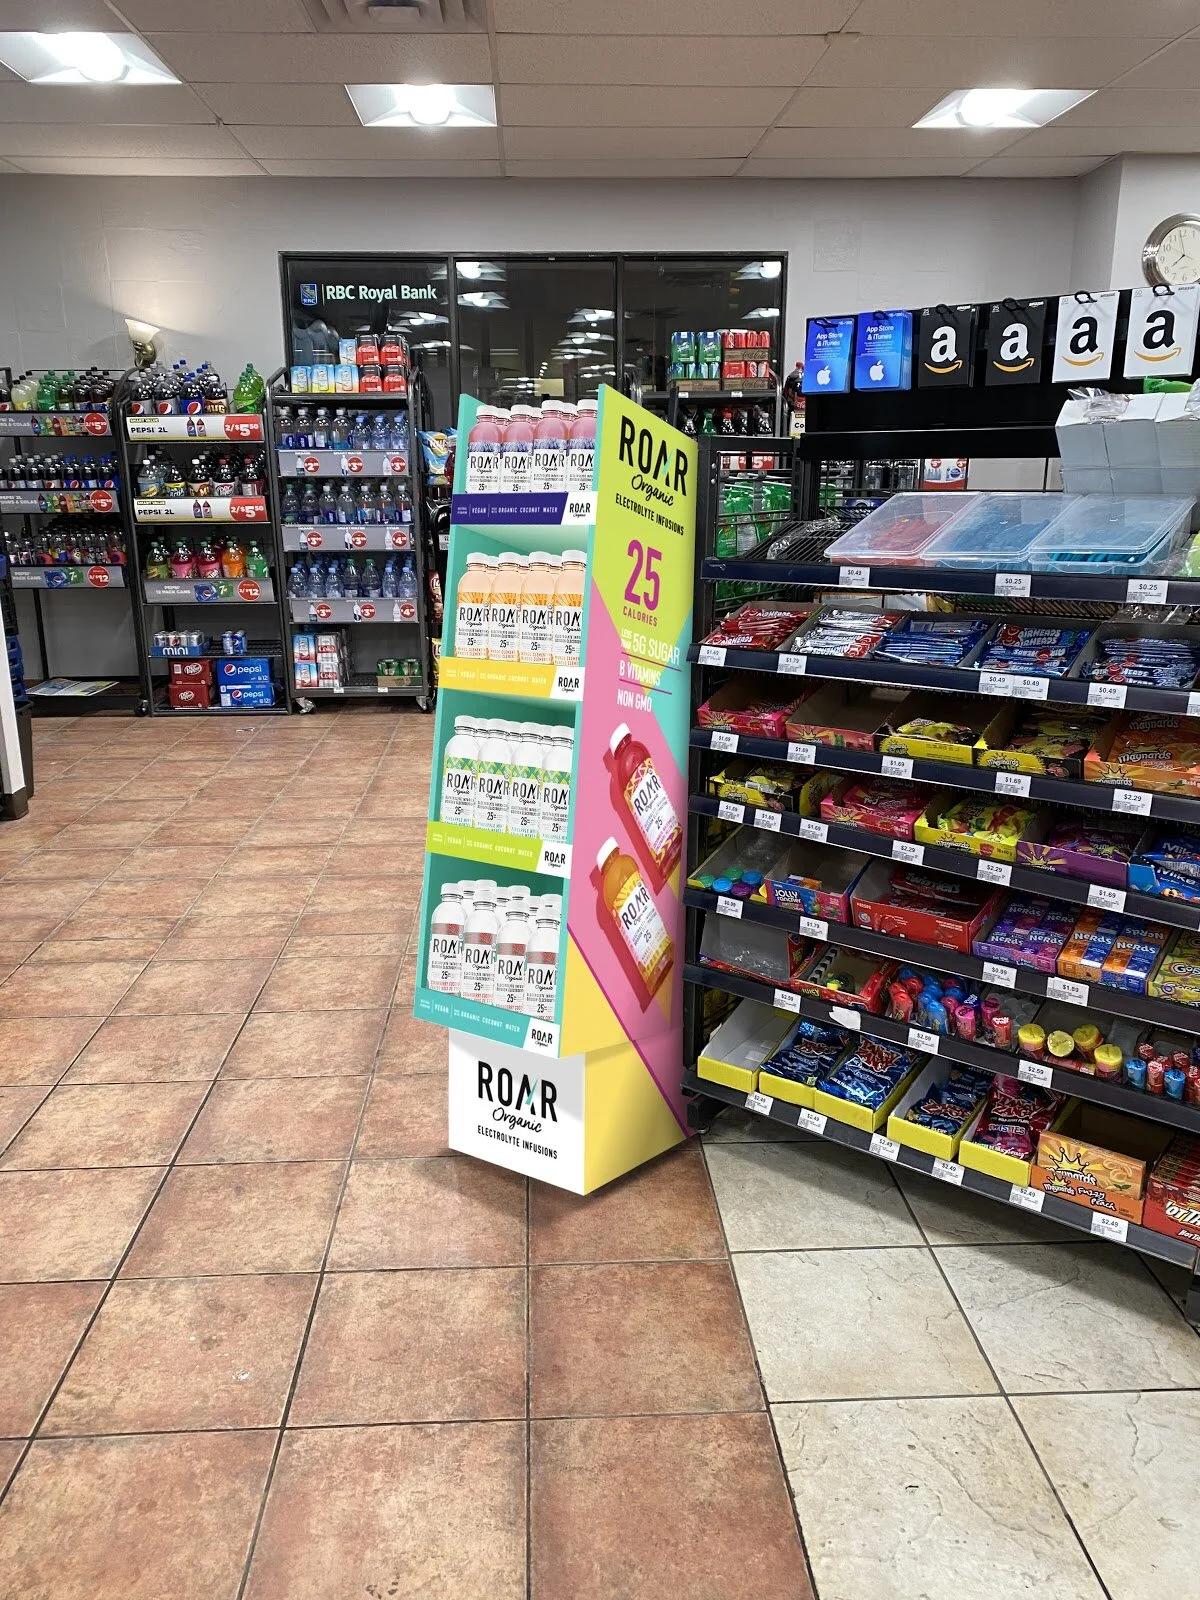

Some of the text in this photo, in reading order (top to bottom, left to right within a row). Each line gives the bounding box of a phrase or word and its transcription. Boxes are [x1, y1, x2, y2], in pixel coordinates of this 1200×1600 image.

[326, 284, 437, 303] RBC Royal Bank
[816, 332, 828, 340] App
[866, 324, 895, 334] App Store
[1069, 316, 1099, 355] a
[1142, 309, 1176, 350] a
[930, 326, 957, 363] a
[1000, 322, 1029, 361] a
[470, 456, 499, 469] ROAR
[534, 453, 565, 467] ROAR
[619, 415, 689, 497] ROAR
[631, 474, 674, 507] Organic
[569, 503, 590, 513] ROAR
[616, 493, 684, 536] ELECTROLYTE INFUSIONS
[624, 539, 662, 611] 25
[460, 607, 489, 622] ROAR
[623, 606, 658, 627] CALORIES
[162, 646, 189, 655] mini
[633, 633, 647, 655] 5G
[648, 638, 680, 666] SUGAR
[237, 665, 262, 675] pepsi
[619, 660, 661, 687] B VITAMINS
[558, 677, 579, 688] ROAR
[243, 690, 264, 699] pepsi
[617, 689, 653, 713] NON GMO
[1118, 751, 1171, 764] Maynards
[479, 777, 509, 795] ROAR
[633, 774, 662, 816] ROAR
[545, 851, 565, 864] ROAR
[987, 865, 1002, 873] $2.29
[775, 889, 798, 898] JOLLY
[621, 887, 650, 930] ROAR
[461, 1011, 480, 1022] ORGANIC
[482, 1017, 502, 1028] COCONUT
[505, 1024, 520, 1032] WATER
[531, 1029, 553, 1044] ROAR
[478, 1060, 558, 1122] ROAR
[492, 1107, 542, 1133] Organic
[478, 1125, 558, 1160] ELECTROLYTE INFUSIONS
[942, 1163, 956, 1172] $2.49
[1043, 1183, 1105, 1199] Maynards Fuzzy
[1090, 1198, 1116, 1211] Peach
[1101, 1218, 1119, 1227] $2.49
